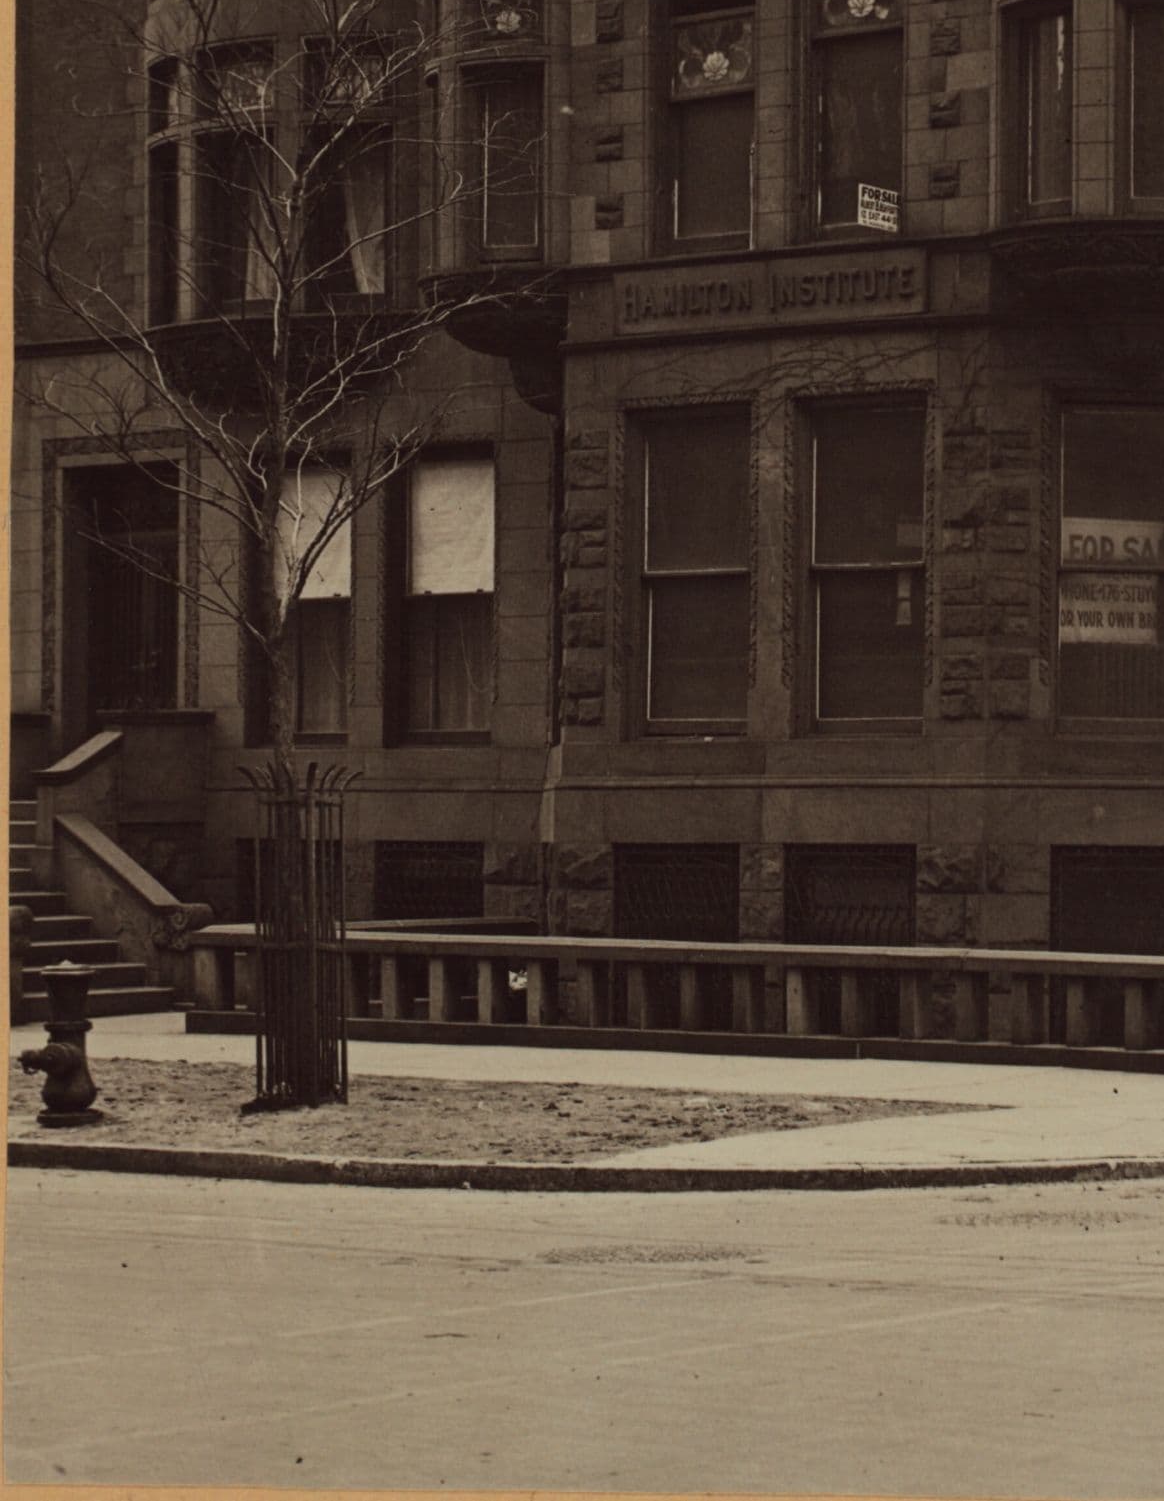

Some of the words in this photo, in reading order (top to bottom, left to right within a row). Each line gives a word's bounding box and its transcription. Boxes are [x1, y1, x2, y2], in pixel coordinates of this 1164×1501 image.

[862, 186, 881, 201] FOR
[622, 278, 753, 323] HAMILTON
[768, 265, 915, 315] INSTITUTE
[1069, 534, 1114, 564] FOR
[1076, 609, 1105, 628] YOUR
[1107, 610, 1136, 629] OWN
